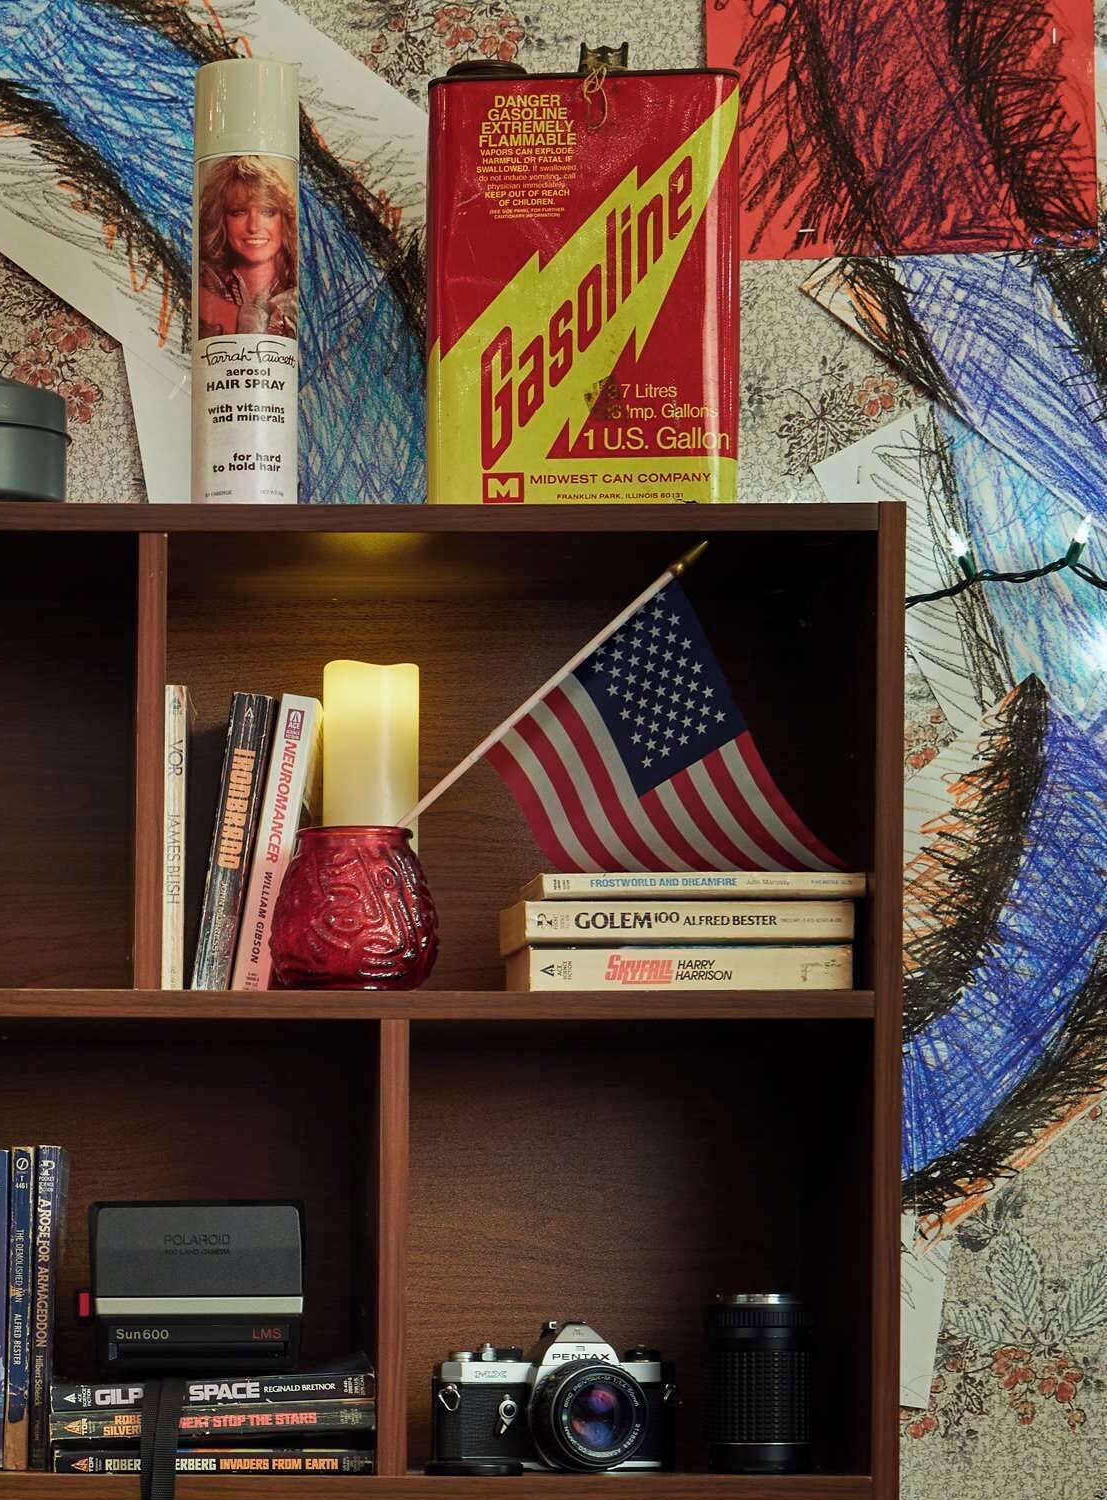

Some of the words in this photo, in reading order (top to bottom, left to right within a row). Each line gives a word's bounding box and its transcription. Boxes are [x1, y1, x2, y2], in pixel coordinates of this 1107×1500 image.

[494, 94, 561, 108] DANGER
[488, 107, 568, 121] GASOLINE
[481, 120, 575, 134] EXTREMELY
[479, 133, 577, 147] FLAMMABLE
[480, 148, 513, 156] VAPORS
[535, 147, 573, 155] EXPLODE
[480, 154, 693, 471] Gasoline
[226, 367, 271, 377] aerosol
[206, 379, 241, 392] HAIR
[245, 379, 285, 391] SPRAY
[635, 383, 678, 399] Litres
[208, 403, 233, 415] with
[237, 403, 285, 415] vitamins
[661, 403, 718, 419] Gallons
[212, 413, 234, 424] and
[237, 413, 285, 424] minerals
[583, 429, 595, 451] 1
[603, 427, 649, 451] U.S.
[656, 426, 731, 451] Gallon
[233, 452, 252, 462] for
[255, 452, 281, 463] hard
[213, 464, 225, 473] to
[229, 462, 256, 471] hold
[259, 463, 281, 472] hair
[530, 474, 598, 485] MIDWEST
[604, 473, 633, 484] CAN
[637, 472, 711, 483] COMPANY
[168, 739, 183, 777] VOR
[267, 740, 297, 864] NEUROMANCER
[258, 871, 273, 918] WILLIAM
[683, 915, 731, 926] ALFRED
[732, 915, 777, 926] BESTER
[251, 921, 265, 964] GIBSON
[677, 960, 715, 970] HARRY
[675, 970, 733, 981] HARRISON
[163, 1233, 231, 1246] POLAROID
[13, 1313, 22, 1338] ALFRED
[252, 1328, 282, 1340] LMS
[13, 1339, 22, 1365] BESTER
[552, 1353, 611, 1361] PENTAX
[474, 1370, 507, 1378] MX
[188, 1382, 261, 1402] SPACE
[263, 1385, 301, 1393] REGINALD
[302, 1383, 336, 1391] BRETNOR
[219, 1458, 269, 1470] INVADERS
[272, 1458, 302, 1470] FROM
[305, 1458, 339, 1470] EARTH
